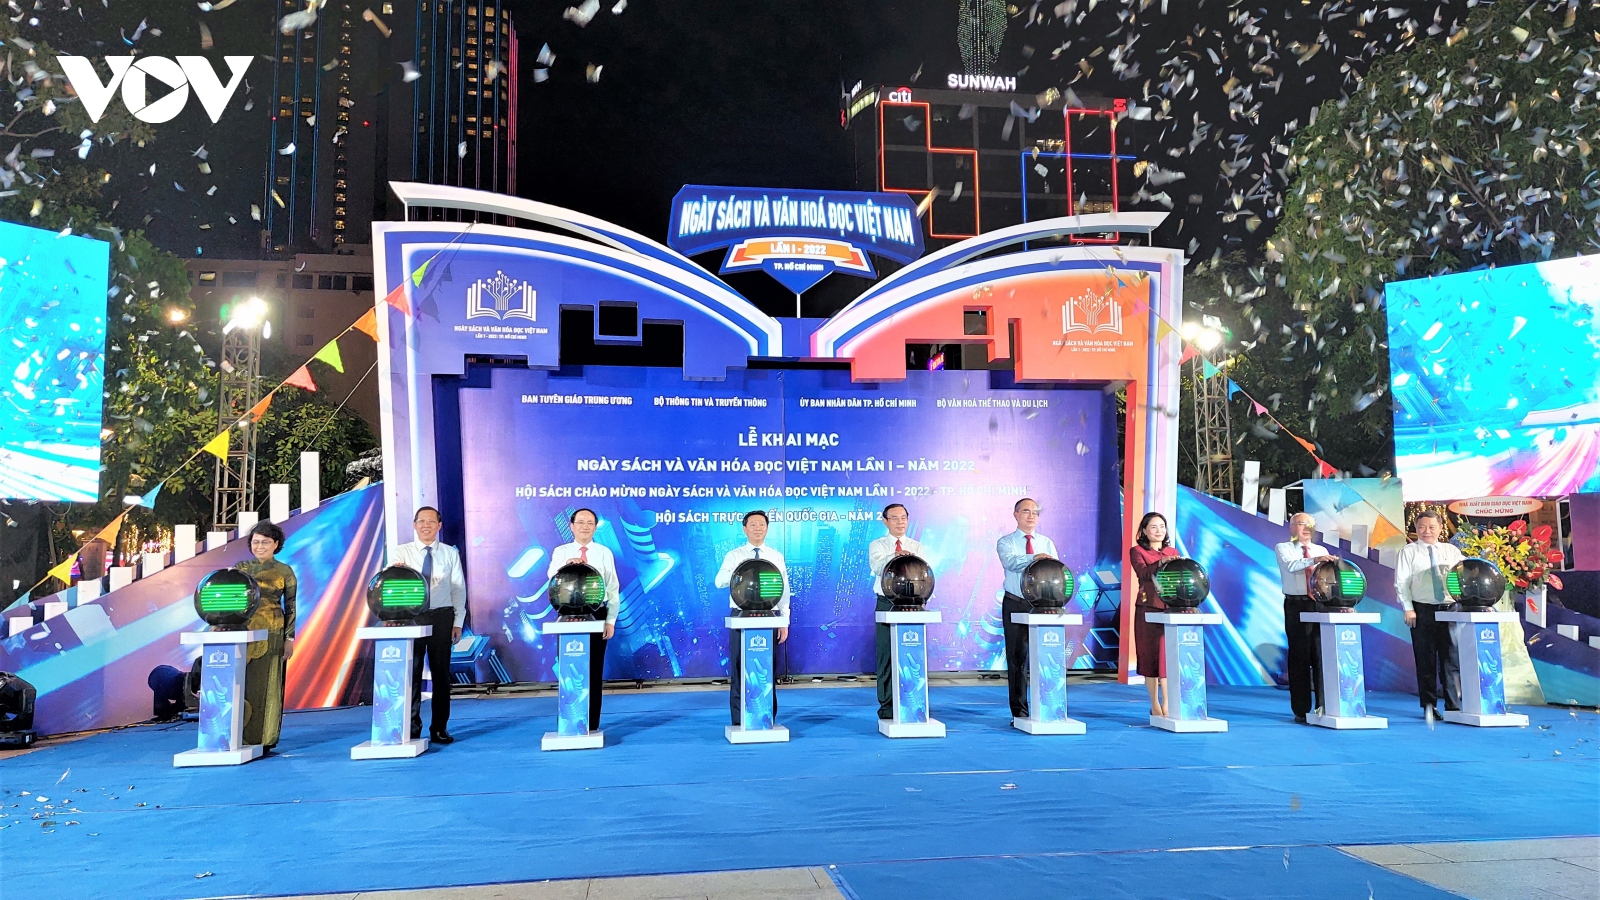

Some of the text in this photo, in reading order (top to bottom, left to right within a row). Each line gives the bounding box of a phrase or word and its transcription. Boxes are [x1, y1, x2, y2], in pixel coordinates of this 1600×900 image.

[947, 73, 1017, 91] SUNWAH
[679, 195, 915, 246] NGÀY SÁCH VÀ VĂN HOÁ ĐỌC VIỆT NAM
[803, 244, 827, 255] 2022
[773, 262, 783, 270] TP.
[796, 261, 806, 271] CHÍ
[806, 263, 824, 271] MINH
[522, 394, 633, 406] BAN TUYÊN GIÁO TRUNG ƯƠNG
[654, 395, 768, 408] BỘ THÔNG TIN VÀ TRUYỀN THÔNG
[800, 396, 917, 408] ỦY BAN NHÂN DÂN TP. HỒ CHÍ MINH
[937, 397, 947, 410] BỘ
[948, 397, 962, 408] VĂN
[963, 397, 978, 408] HOÁ
[993, 398, 1011, 408] THAO
[1012, 397, 1022, 408] VÀ
[1023, 399, 1033, 408] DU
[1034, 399, 1048, 409] LỊCH
[739, 427, 839, 449] LỄ KHAI MẠC
[578, 457, 619, 471] NGÀY
[621, 457, 661, 471] SÁCH
[665, 457, 684, 471] VÀ
[688, 457, 717, 471] VĂN
[721, 458, 750, 472] HÓA
[753, 461, 783, 474] ĐỌC
[787, 457, 818, 473] VIỆT
[821, 461, 853, 471] NAM
[857, 457, 886, 471] LẦN
[889, 461, 893, 471] I
[908, 458, 939, 471] NĂM
[942, 460, 975, 471] 2022
[516, 485, 537, 500] HỘI
[539, 485, 572, 498] SÁCH
[574, 485, 607, 498] CHÀO
[610, 484, 646, 498] MỪNG
[649, 485, 680, 497] NGÀY
[683, 484, 713, 497] SÁCH
[716, 485, 731, 497] VÀ
[733, 485, 756, 497] VĂN
[759, 484, 783, 497] HÓA
[785, 486, 808, 500] ĐỌC
[810, 484, 835, 499] VIỆT
[838, 486, 863, 496] NAM
[865, 483, 888, 496] LẦN
[890, 486, 894, 496] I
[904, 486, 930, 496] 2022
[940, 486, 956, 496] TP.
[998, 486, 1027, 496] MINH
[655, 510, 676, 525] HỘI
[678, 509, 709, 522] SÁCH
[786, 508, 817, 522] QUỐC
[819, 511, 839, 521] GIA
[848, 509, 874, 521] NĂM
